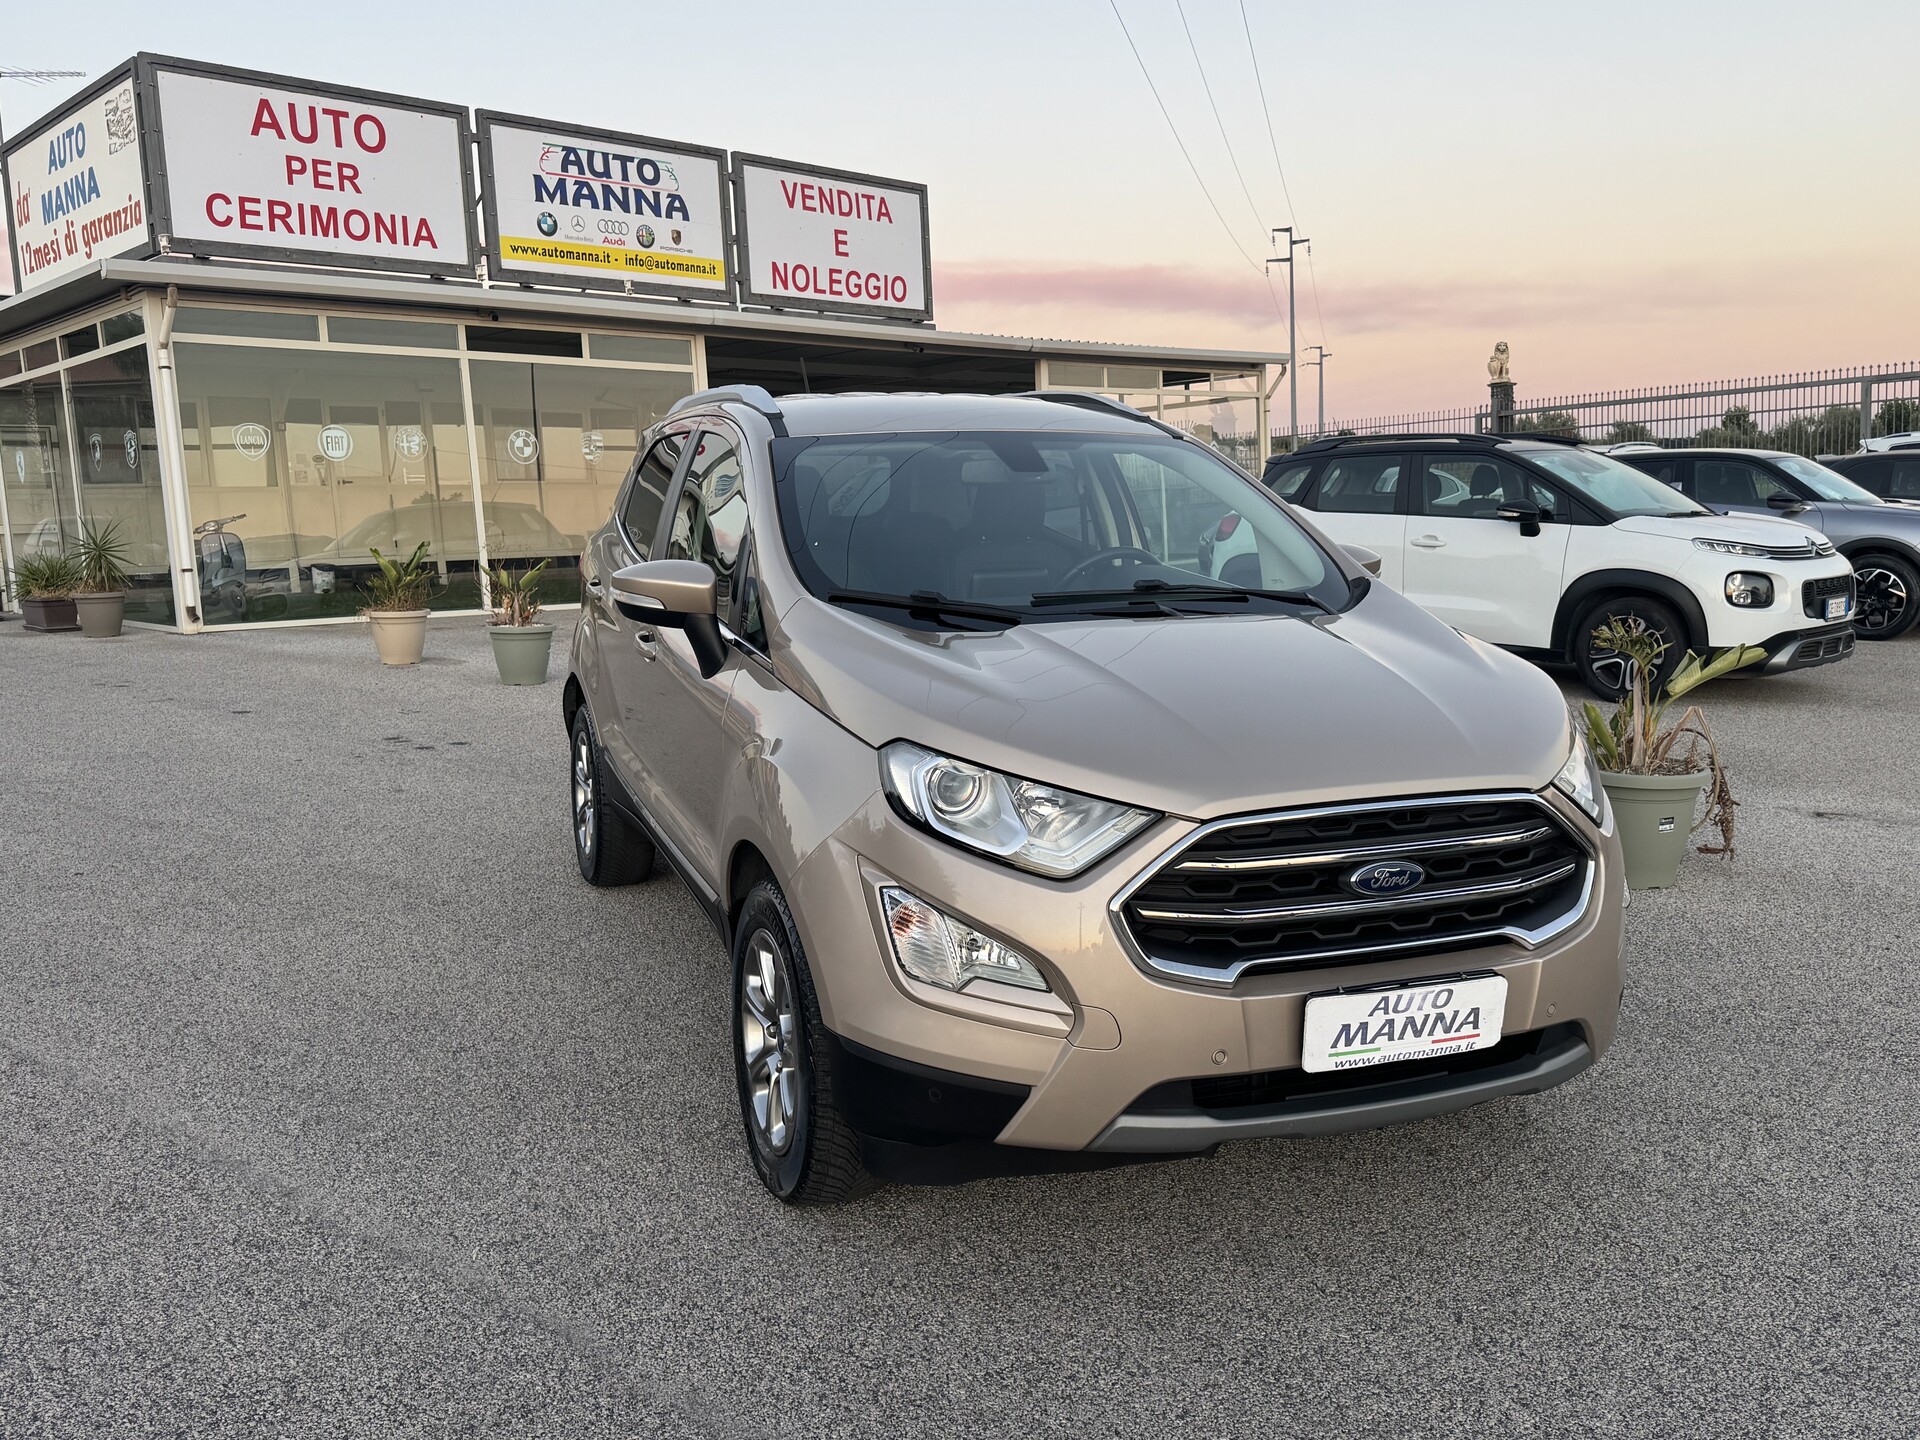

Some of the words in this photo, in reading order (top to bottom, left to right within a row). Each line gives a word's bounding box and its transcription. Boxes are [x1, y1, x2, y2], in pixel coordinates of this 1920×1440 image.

[250, 97, 387, 153] AUTO
[48, 121, 86, 175] AUTO
[560, 146, 661, 186] AUTO
[285, 154, 363, 195] PER
[41, 166, 101, 226] MANNA
[532, 173, 690, 222] MANNA
[780, 179, 893, 224] VENDITA
[20, 228, 62, 277] 12mesi
[64, 219, 79, 257] di
[81, 193, 143, 260] garanzia
[205, 192, 438, 249] CERIMONIA
[602, 235, 626, 247] Audi
[510, 244, 611, 264] www.automanna.it
[625, 253, 717, 275] info@automanna.it
[833, 228, 849, 257] E
[771, 261, 907, 303] NOLEGGIO
[240, 435, 264, 445] LANCIA
[325, 435, 344, 451] FIAT
[1371, 868, 1410, 888] Ford
[1368, 988, 1454, 1017] AUTO
[1330, 1007, 1480, 1049] MANNA
[1334, 1041, 1476, 1069] www.automanna.it
